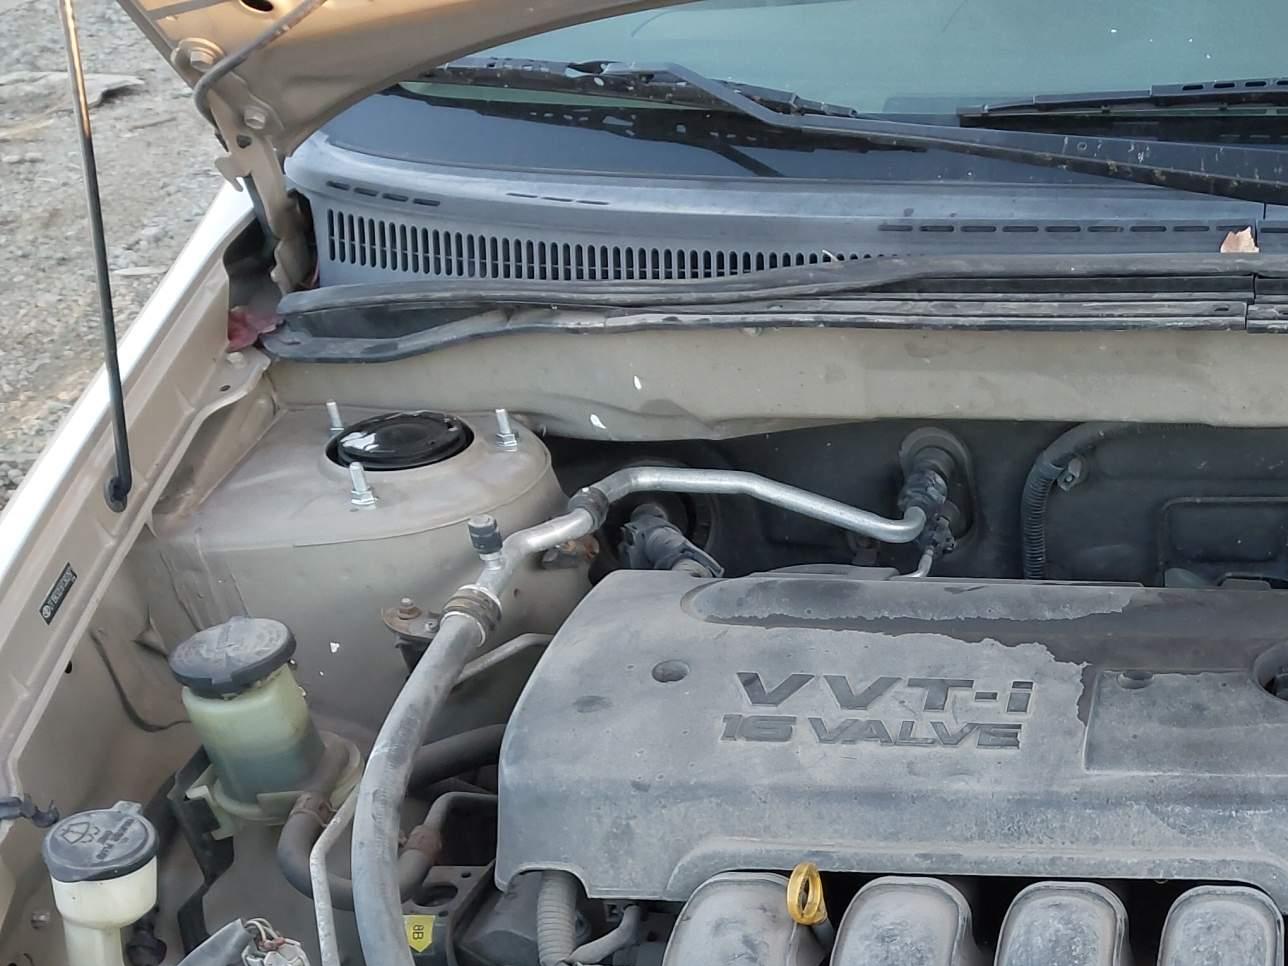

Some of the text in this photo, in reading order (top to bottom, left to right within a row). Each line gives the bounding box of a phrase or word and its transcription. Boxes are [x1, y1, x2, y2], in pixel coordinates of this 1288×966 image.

[736, 672, 1034, 712] VVT-i
[721, 713, 1021, 749] 16 VALVE
